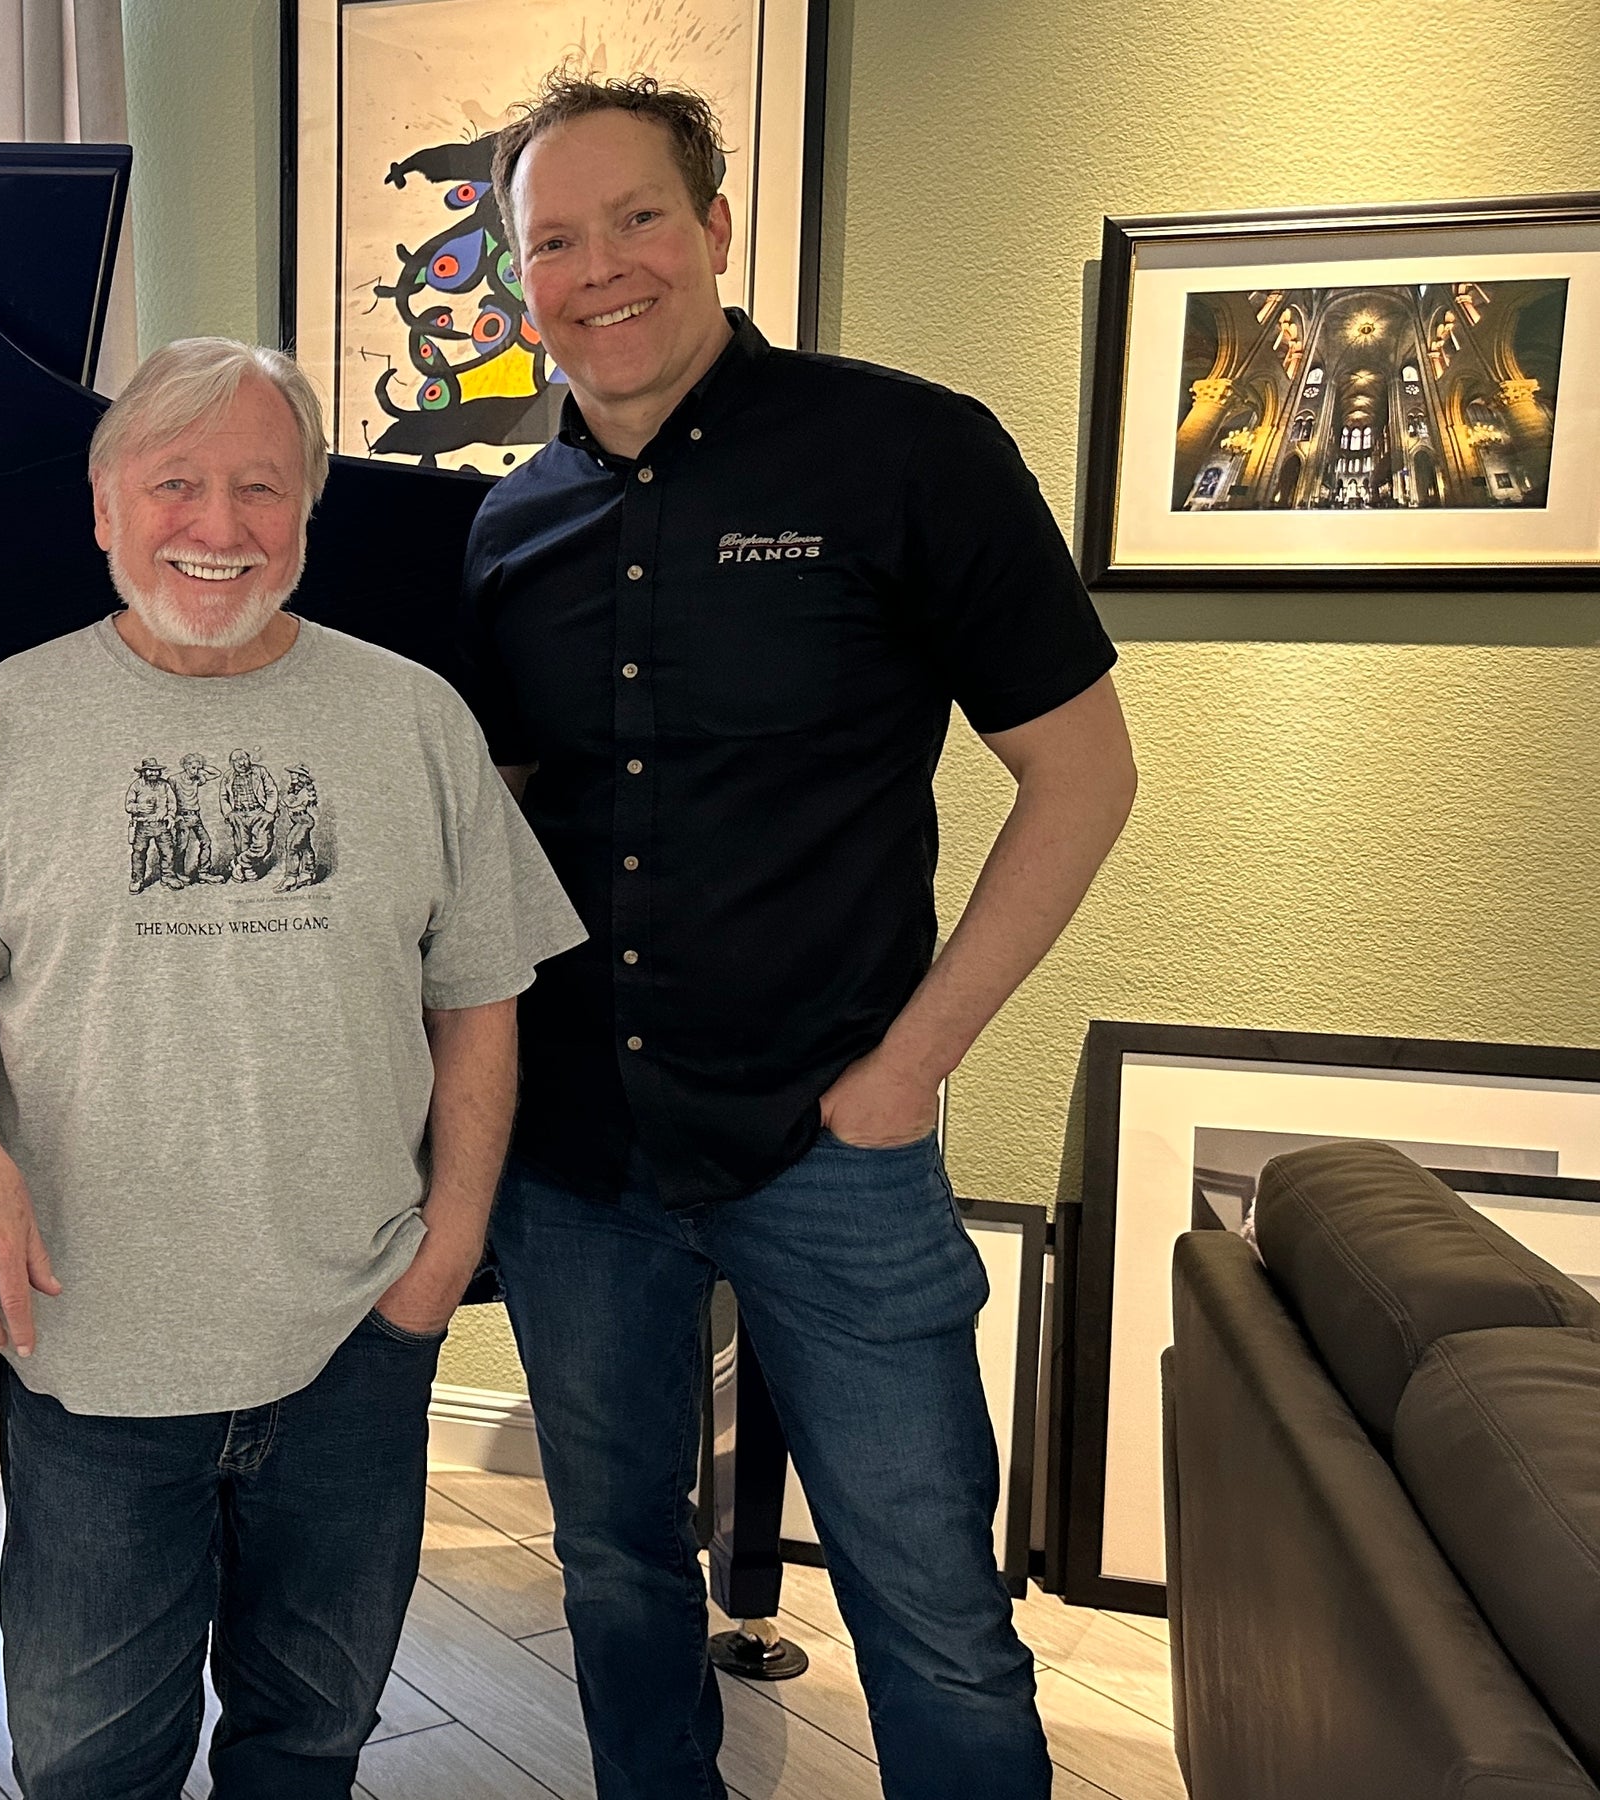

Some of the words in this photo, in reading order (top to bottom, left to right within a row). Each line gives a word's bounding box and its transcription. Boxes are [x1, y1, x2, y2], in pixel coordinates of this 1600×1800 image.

[719, 532, 775, 549] Brigham
[718, 546, 820, 563] PIANOS
[135, 922, 162, 936] THE
[166, 922, 224, 936] MONKEY
[228, 918, 288, 934] WRENCH
[292, 916, 329, 931] GANG
